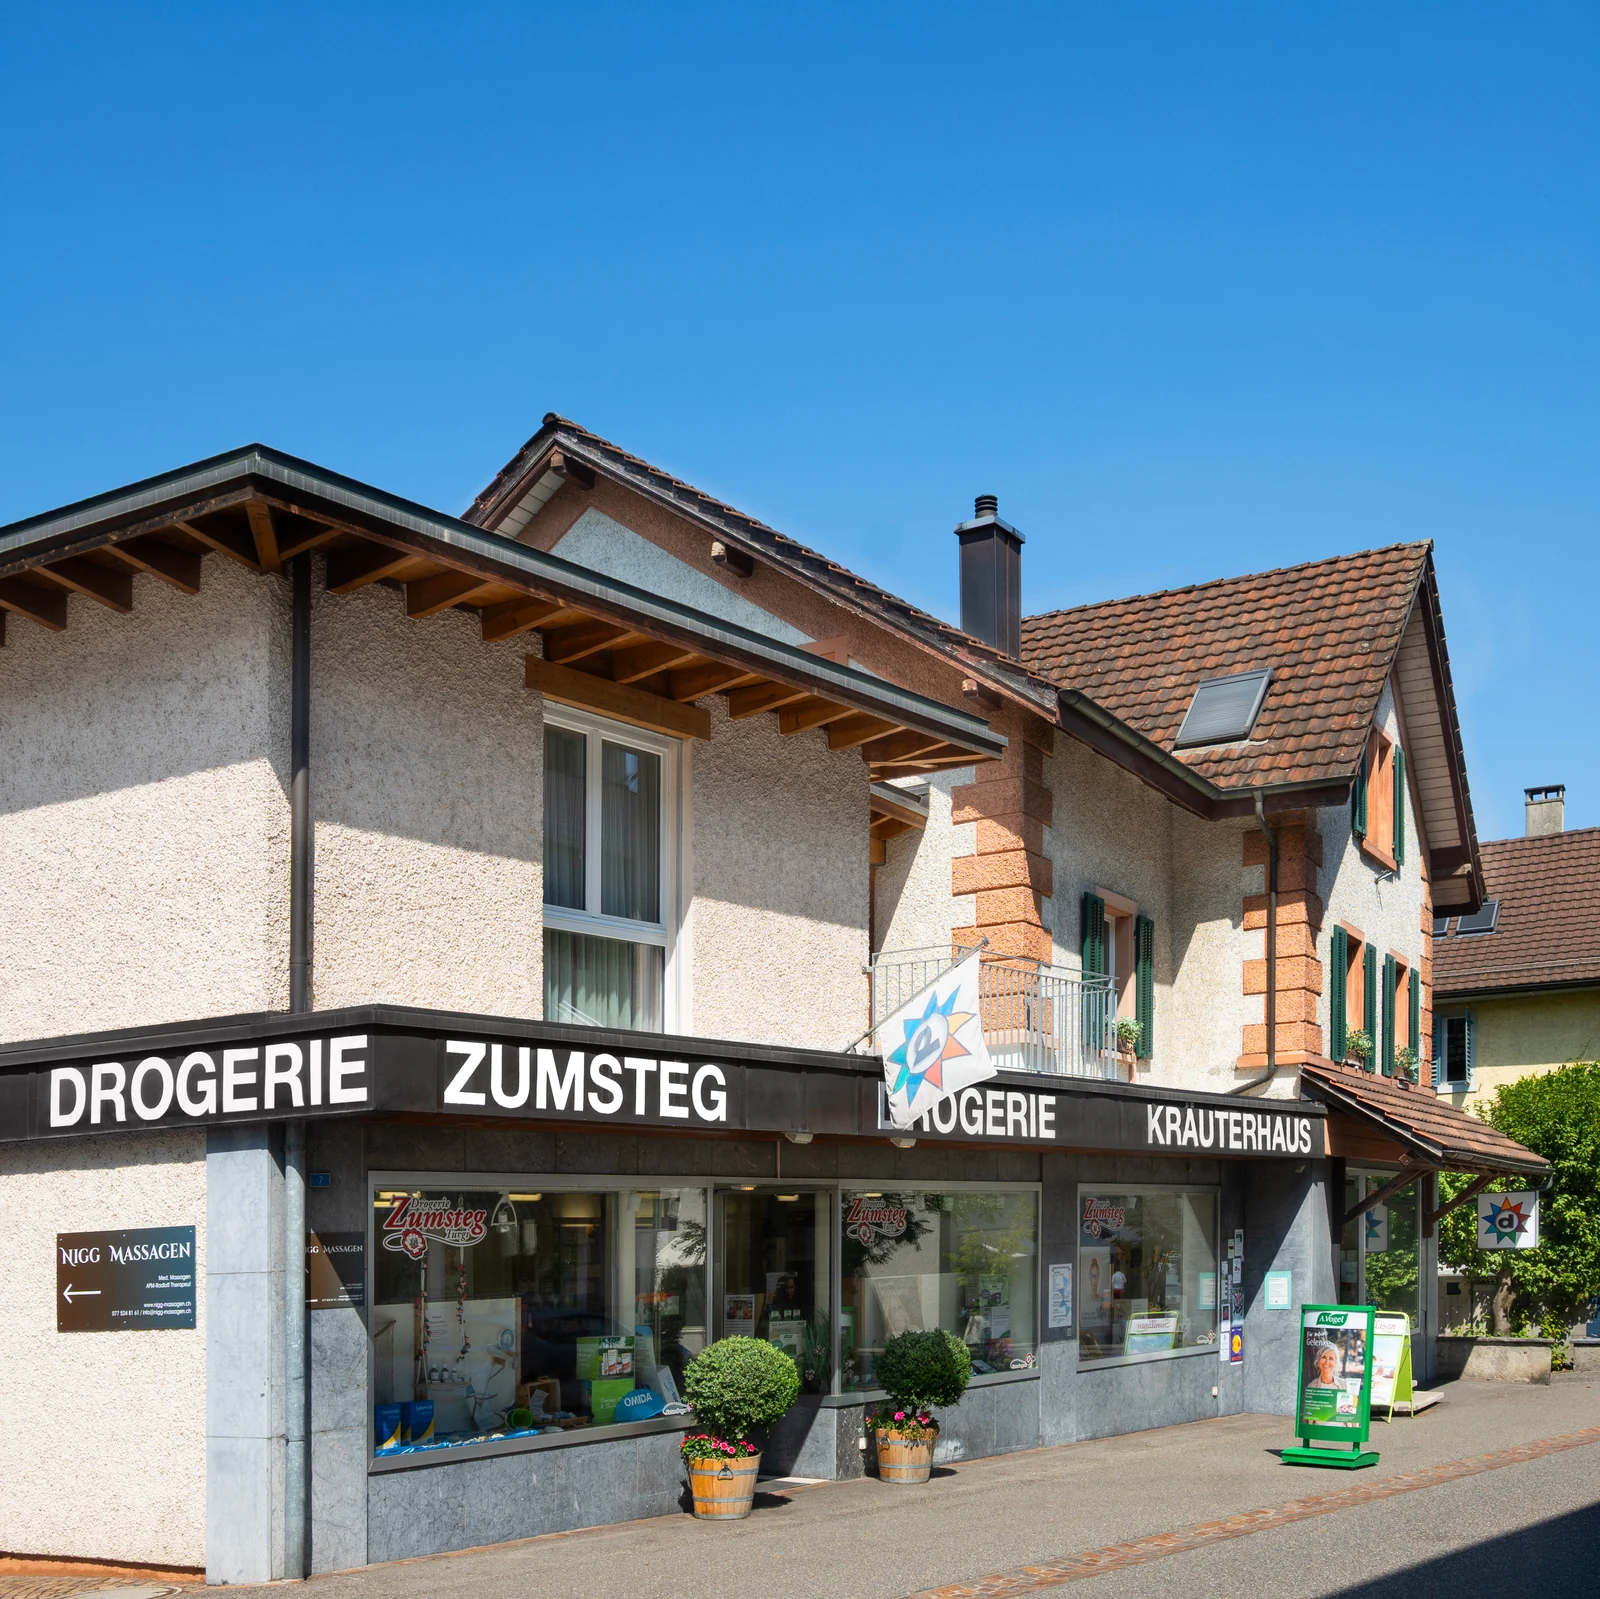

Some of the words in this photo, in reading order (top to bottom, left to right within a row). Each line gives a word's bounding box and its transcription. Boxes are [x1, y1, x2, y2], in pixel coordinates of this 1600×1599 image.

[50, 1034, 368, 1128] DROGERIE
[443, 1039, 727, 1122] ZUMSTEG
[411, 1197, 451, 1210] Drogerie
[848, 1197, 906, 1229] Zumsteg
[1083, 1198, 1125, 1224] Zumsteg
[384, 1194, 486, 1235] Zumsteg
[1497, 1213, 1514, 1229] d
[446, 1229, 470, 1242] Turgi
[59, 1246, 101, 1267] NIGG
[108, 1241, 191, 1265] MASSAGEN
[305, 1245, 319, 1254] IGG
[323, 1244, 363, 1255] MASSAGEN
[143, 1301, 192, 1309] www.nigg-massagen.ch
[623, 1392, 653, 1407] OMIDA
